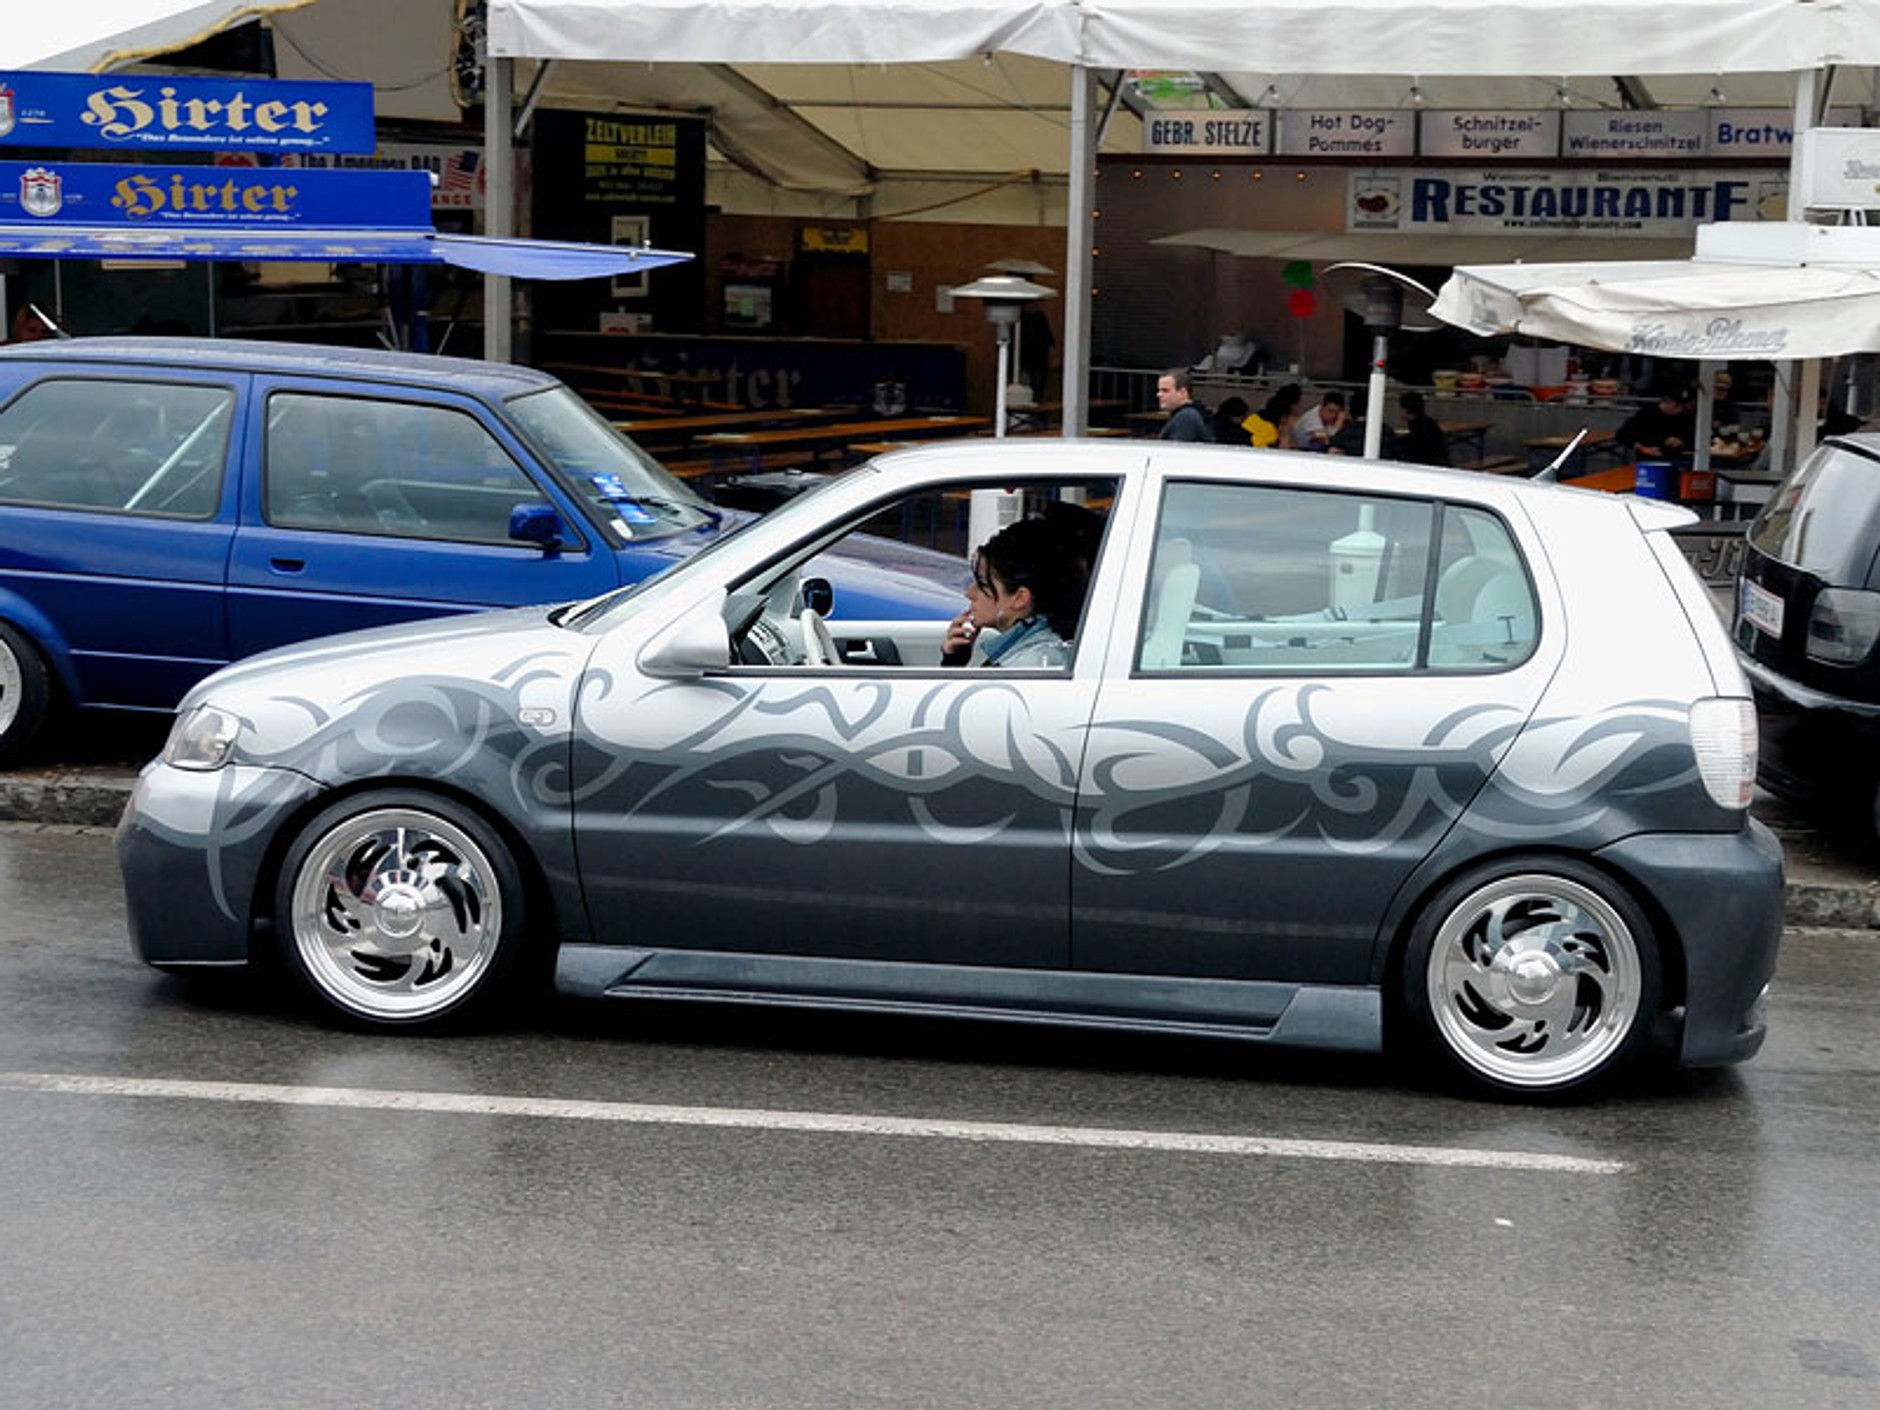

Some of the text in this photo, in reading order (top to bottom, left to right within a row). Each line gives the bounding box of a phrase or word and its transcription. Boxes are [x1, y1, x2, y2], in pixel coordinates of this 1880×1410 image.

[80, 86, 328, 139] Hirter
[1310, 114, 1342, 130] Hot
[1608, 119, 1663, 133] Riesen
[1205, 120, 1261, 147] STELZE
[1569, 134, 1701, 150] Wienerschnitzel
[1309, 136, 1382, 152] Pommes
[1462, 134, 1521, 152] burger
[111, 174, 299, 219] Hirter
